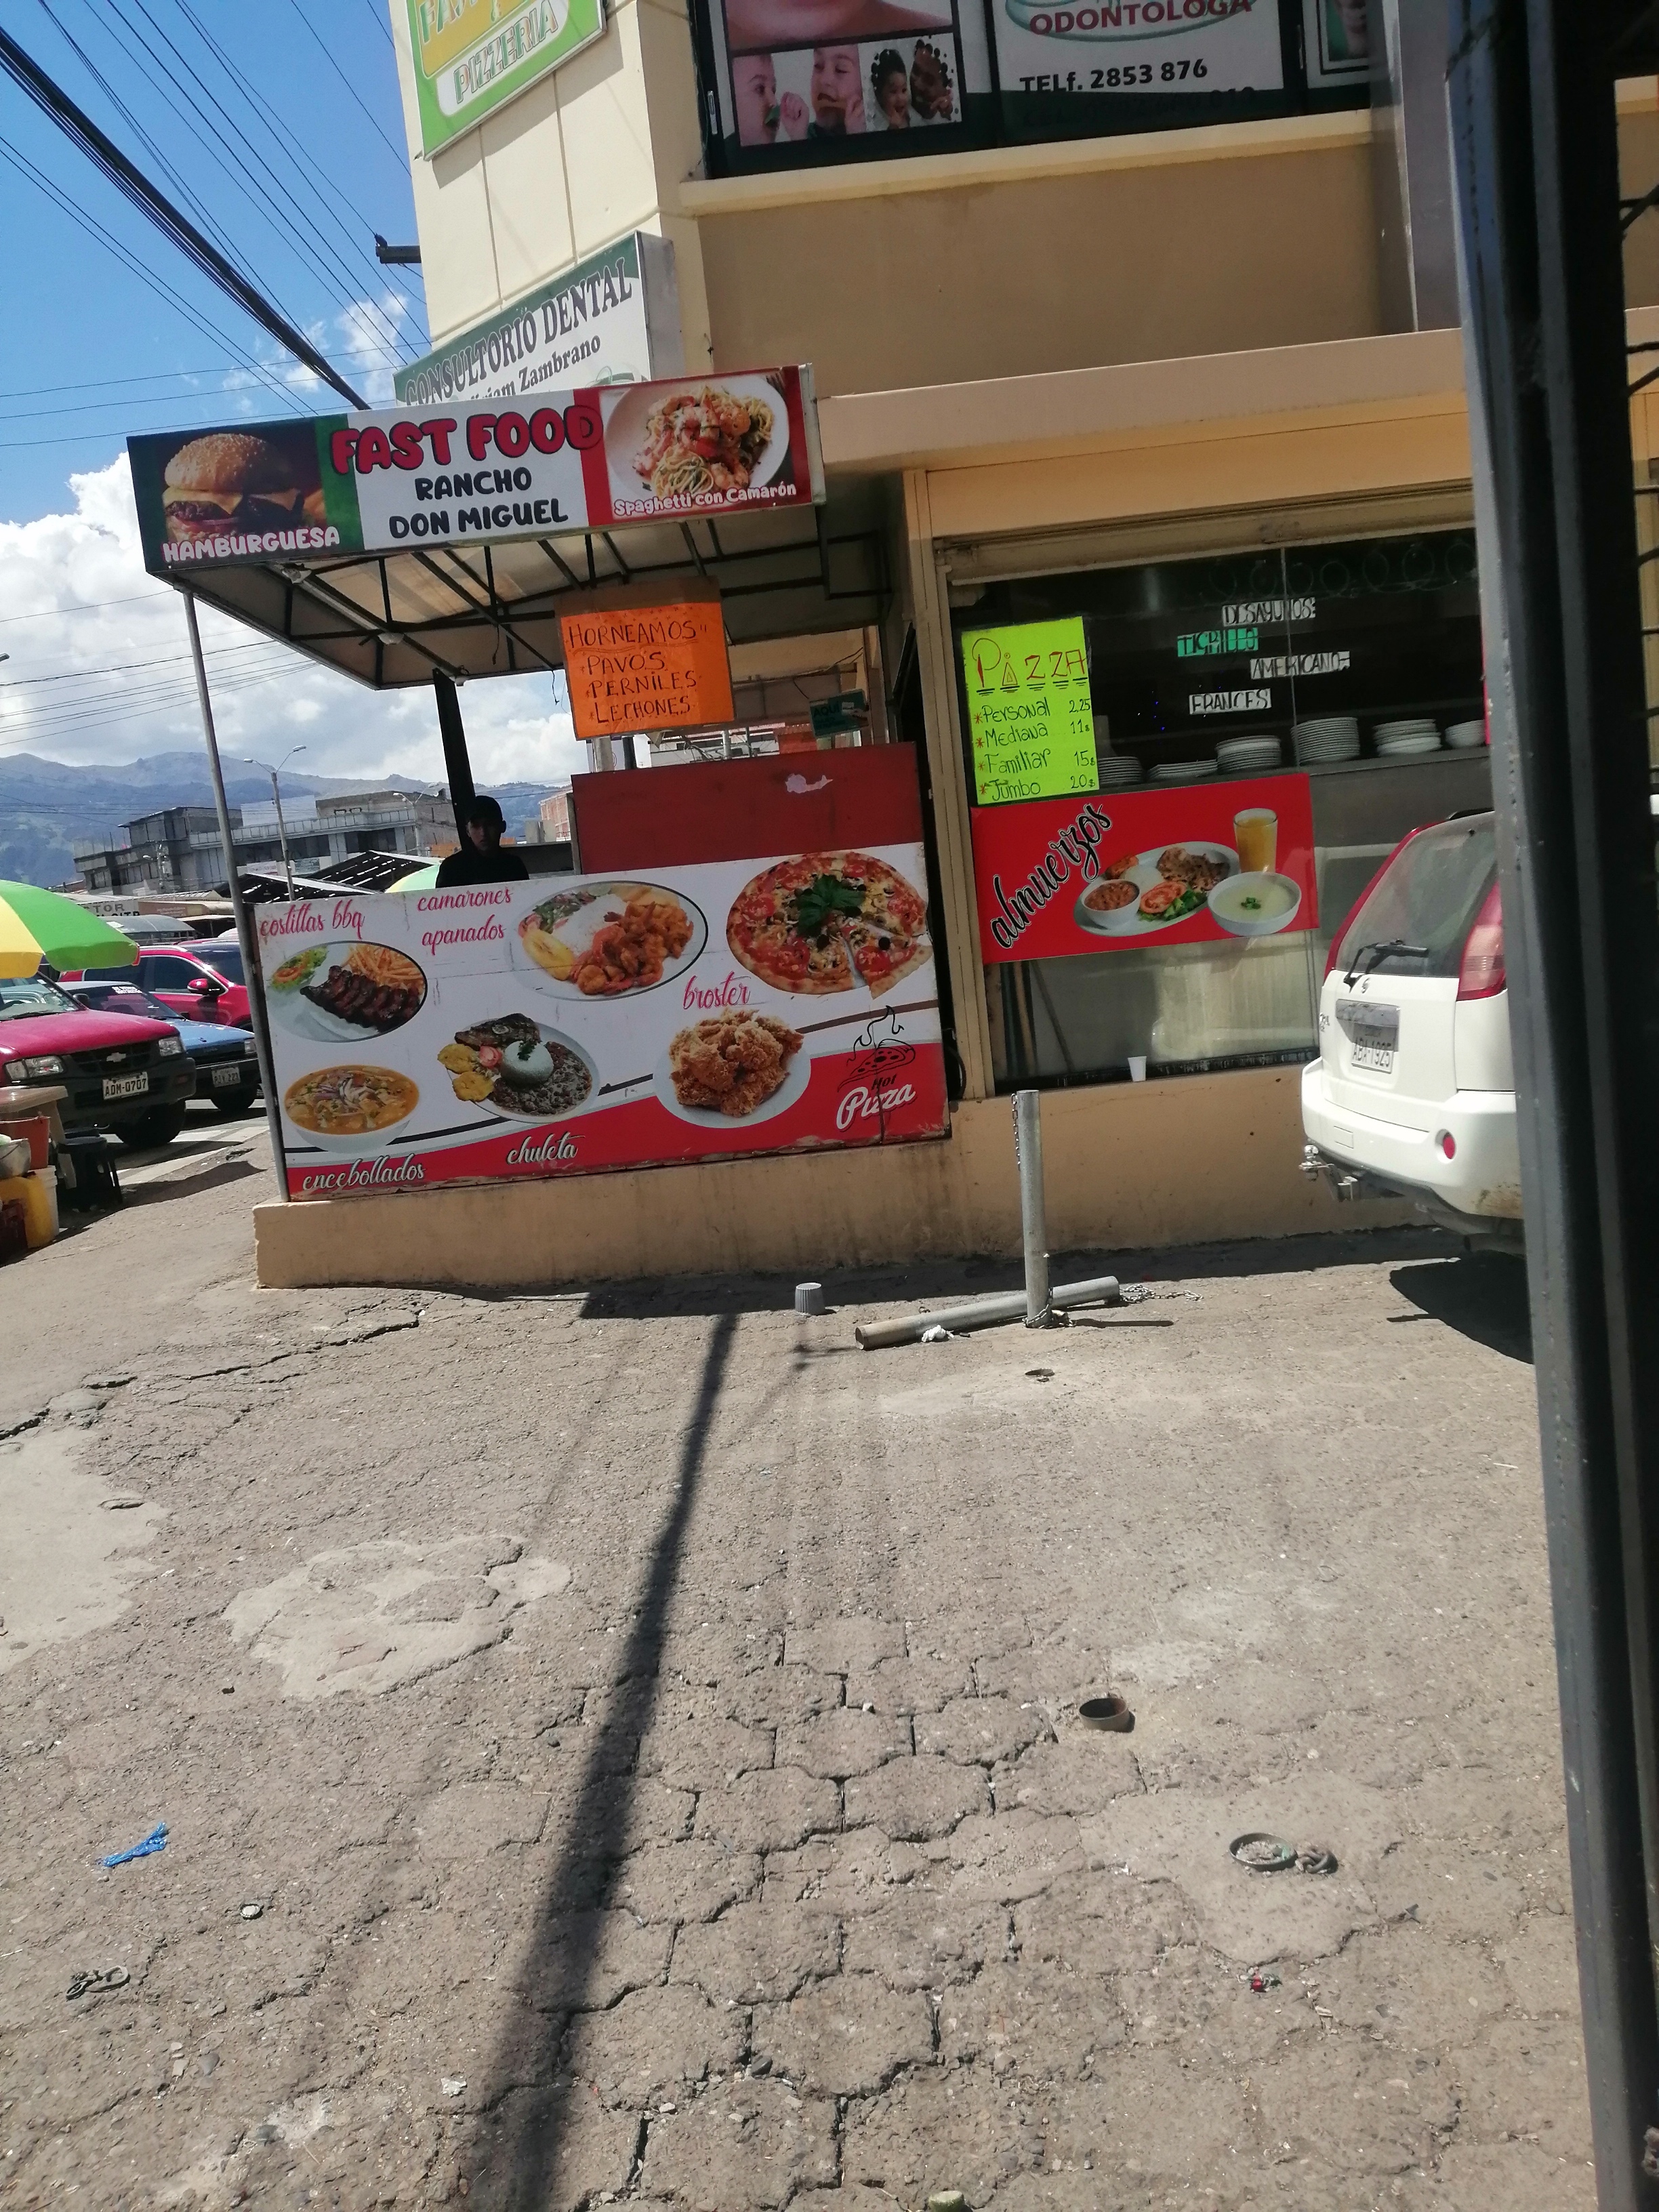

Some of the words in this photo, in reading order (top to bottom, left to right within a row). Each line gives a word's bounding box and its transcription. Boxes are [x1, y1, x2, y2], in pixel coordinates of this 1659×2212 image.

[1030, 0, 1252, 35] ODONTOLOGA
[453, 1, 558, 104] PIZZERIA
[1091, 64, 1153, 89] 2853
[1161, 58, 1208, 82] 876
[405, 310, 537, 407] CONSULTORIO
[541, 258, 632, 344] DENTAL
[518, 335, 600, 393] Zambrano
[331, 418, 457, 474] FAST
[466, 405, 604, 461] FOOD
[415, 466, 532, 501] RANCHO
[614, 493, 691, 516] Spaghetti
[695, 491, 724, 506] con
[726, 481, 796, 502] Camarón
[389, 514, 450, 539] DON
[458, 497, 568, 532] MIGUEL
[162, 527, 340, 563] HAMBURGUESA
[587, 651, 665, 674] PAVOS
[589, 670, 697, 698] PERNILES
[594, 695, 691, 723] LECHONES
[985, 722, 1048, 747] Mediana
[985, 748, 1051, 773] Familiar
[991, 779, 1041, 801] Jumbo
[991, 804, 1111, 949] almuerzos
[417, 886, 513, 912] camarones
[260, 905, 325, 937] costillas
[333, 900, 365, 939] bbq
[422, 914, 506, 956] apanados
[683, 971, 751, 1010] broster
[106, 1078, 146, 1096] ADM-0707
[836, 1084, 917, 1130] Pizza
[507, 1132, 586, 1164] chuleta
[303, 1153, 425, 1191] encebollados
